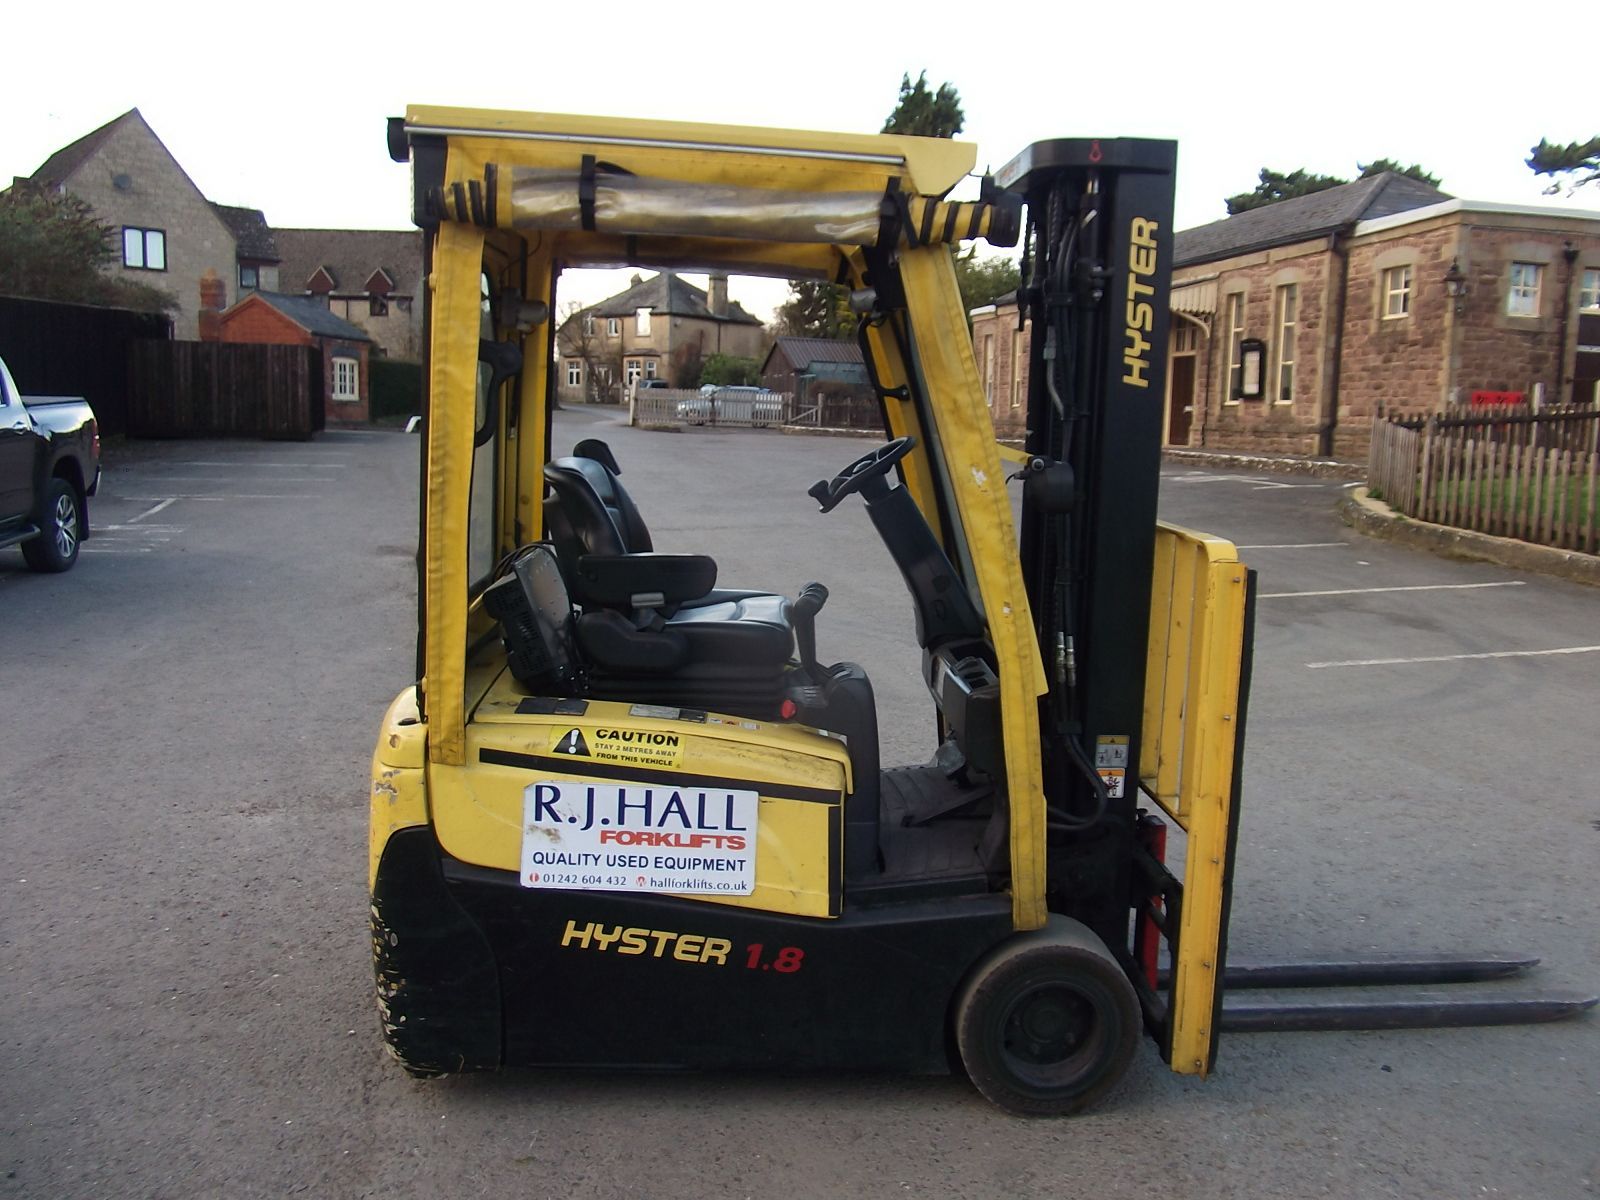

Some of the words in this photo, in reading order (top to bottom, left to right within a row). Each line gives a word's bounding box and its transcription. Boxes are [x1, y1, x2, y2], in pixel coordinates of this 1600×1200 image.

[1121, 216, 1159, 388] HYSTER
[595, 729, 679, 746] CAUTION
[596, 752, 618, 760] FROM
[620, 755, 638, 763] THIS
[640, 757, 673, 766] VEHICLE
[622, 746, 653, 755] METRES
[600, 830, 746, 850] FORKLIFTS
[532, 851, 602, 866] QUALITY
[606, 855, 649, 868] USED
[654, 856, 747, 872] EQUIPMENT
[543, 873, 578, 884] 01242
[581, 875, 602, 885] 604
[606, 877, 627, 886] 432
[650, 877, 748, 891] hallforklifts.co.uk
[561, 920, 732, 965] HYSTER
[745, 943, 805, 973] 1.8
